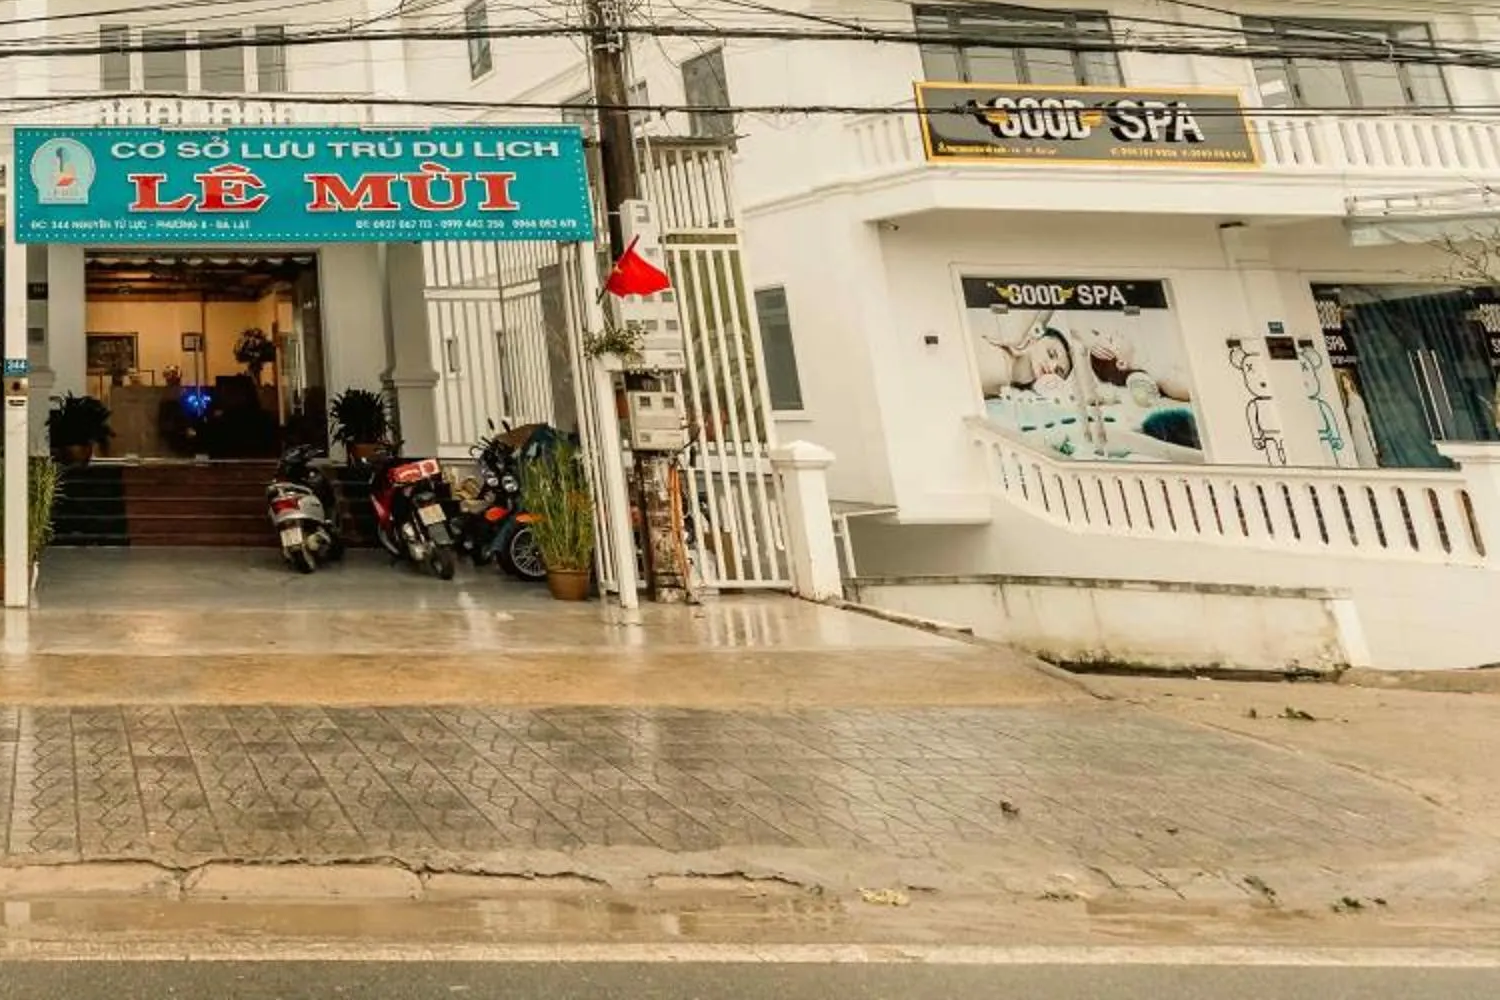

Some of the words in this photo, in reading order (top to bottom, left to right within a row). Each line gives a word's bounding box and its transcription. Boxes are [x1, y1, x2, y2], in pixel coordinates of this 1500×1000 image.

[1114, 99, 1206, 143] SPA
[111, 139, 166, 159] CƠ
[177, 136, 230, 159] SỞ
[241, 139, 316, 159] LƯU
[327, 137, 402, 159] TRÚ
[412, 140, 470, 158] DU
[476, 140, 561, 161] LỊCH
[127, 162, 270, 213] LÊ
[304, 161, 521, 213] MÙI
[1007, 283, 1067, 305] GOOD
[1076, 284, 1128, 306] SPA
